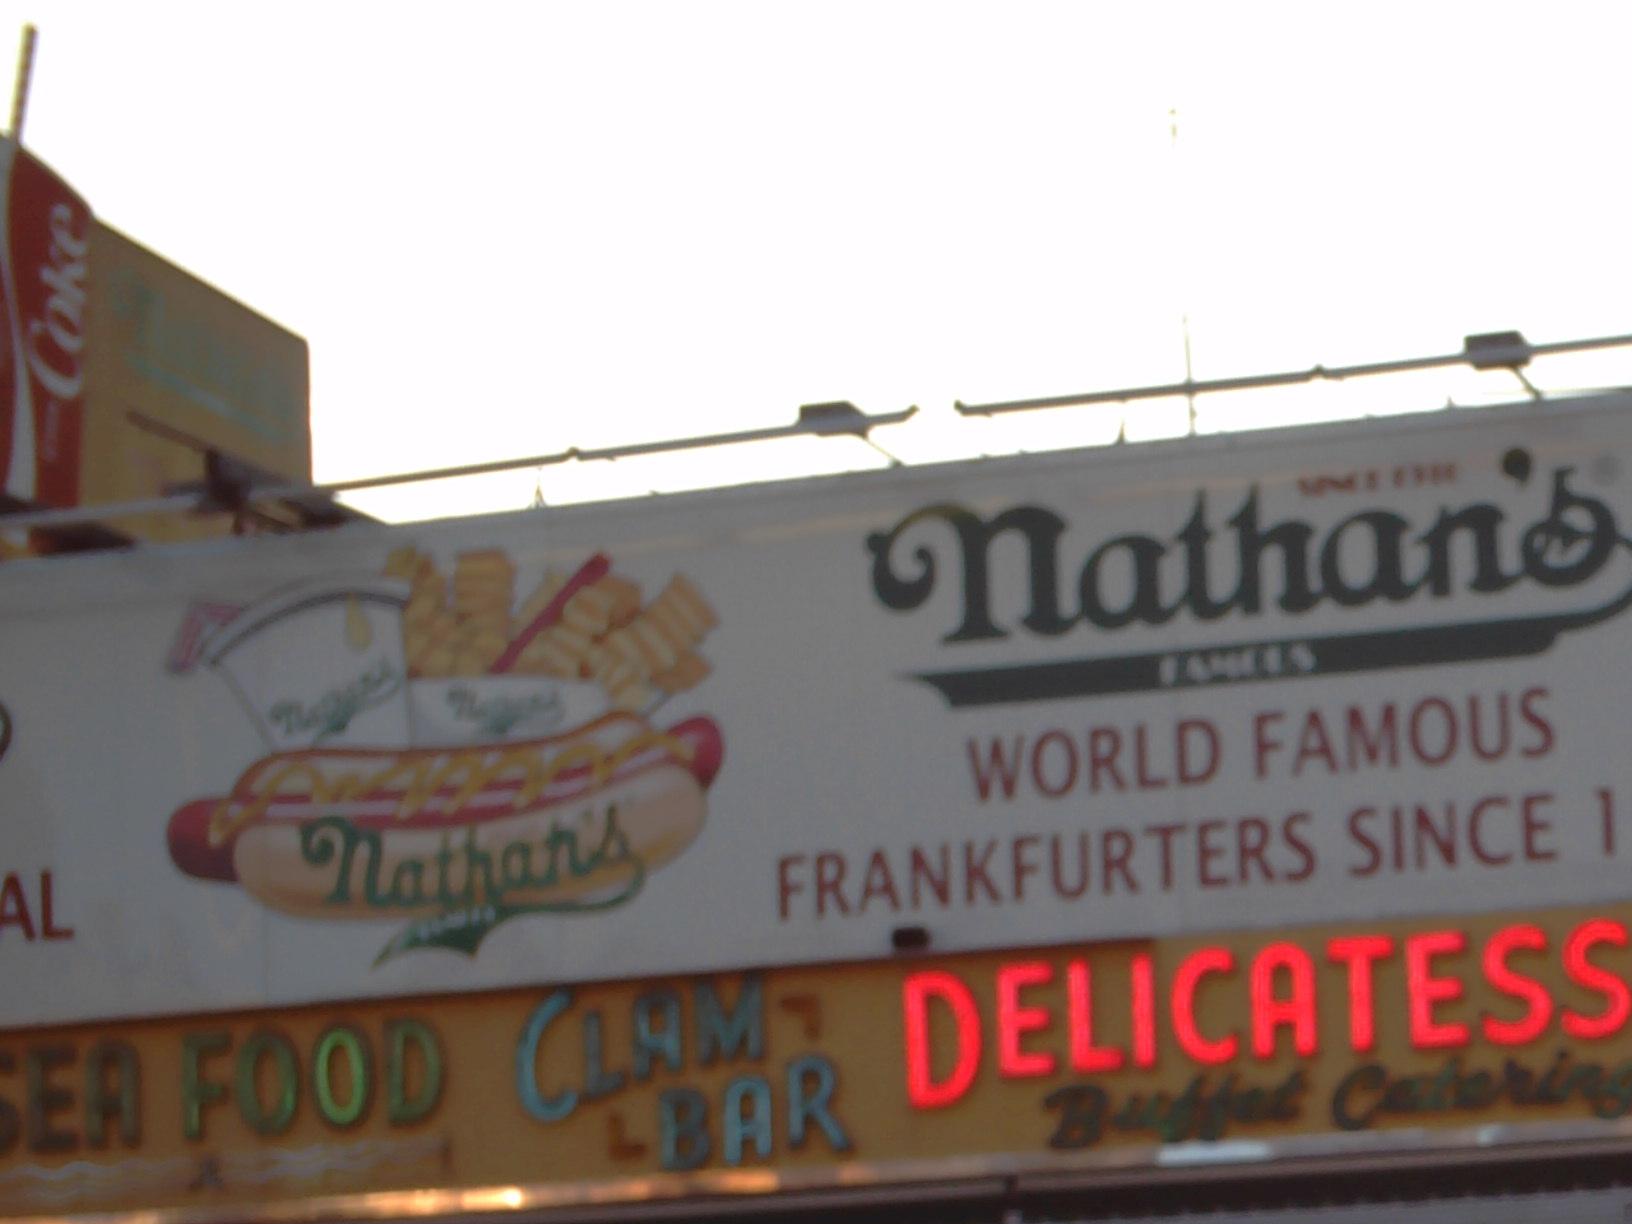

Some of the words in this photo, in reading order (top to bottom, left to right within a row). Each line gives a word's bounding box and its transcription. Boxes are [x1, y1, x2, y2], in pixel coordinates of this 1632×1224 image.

[28, 203, 87, 400] Coke
[965, 718, 1223, 802] WORLD
[1252, 687, 1556, 783] FAMOUS
[777, 811, 1315, 921] FRANKFURTERS
[1349, 793, 1558, 878] SINCE
[181, 1018, 443, 1141] FOOD
[517, 976, 766, 1124] CLAM
[657, 1053, 854, 1170] BAR
[1046, 1063, 1304, 1150] Buffet
